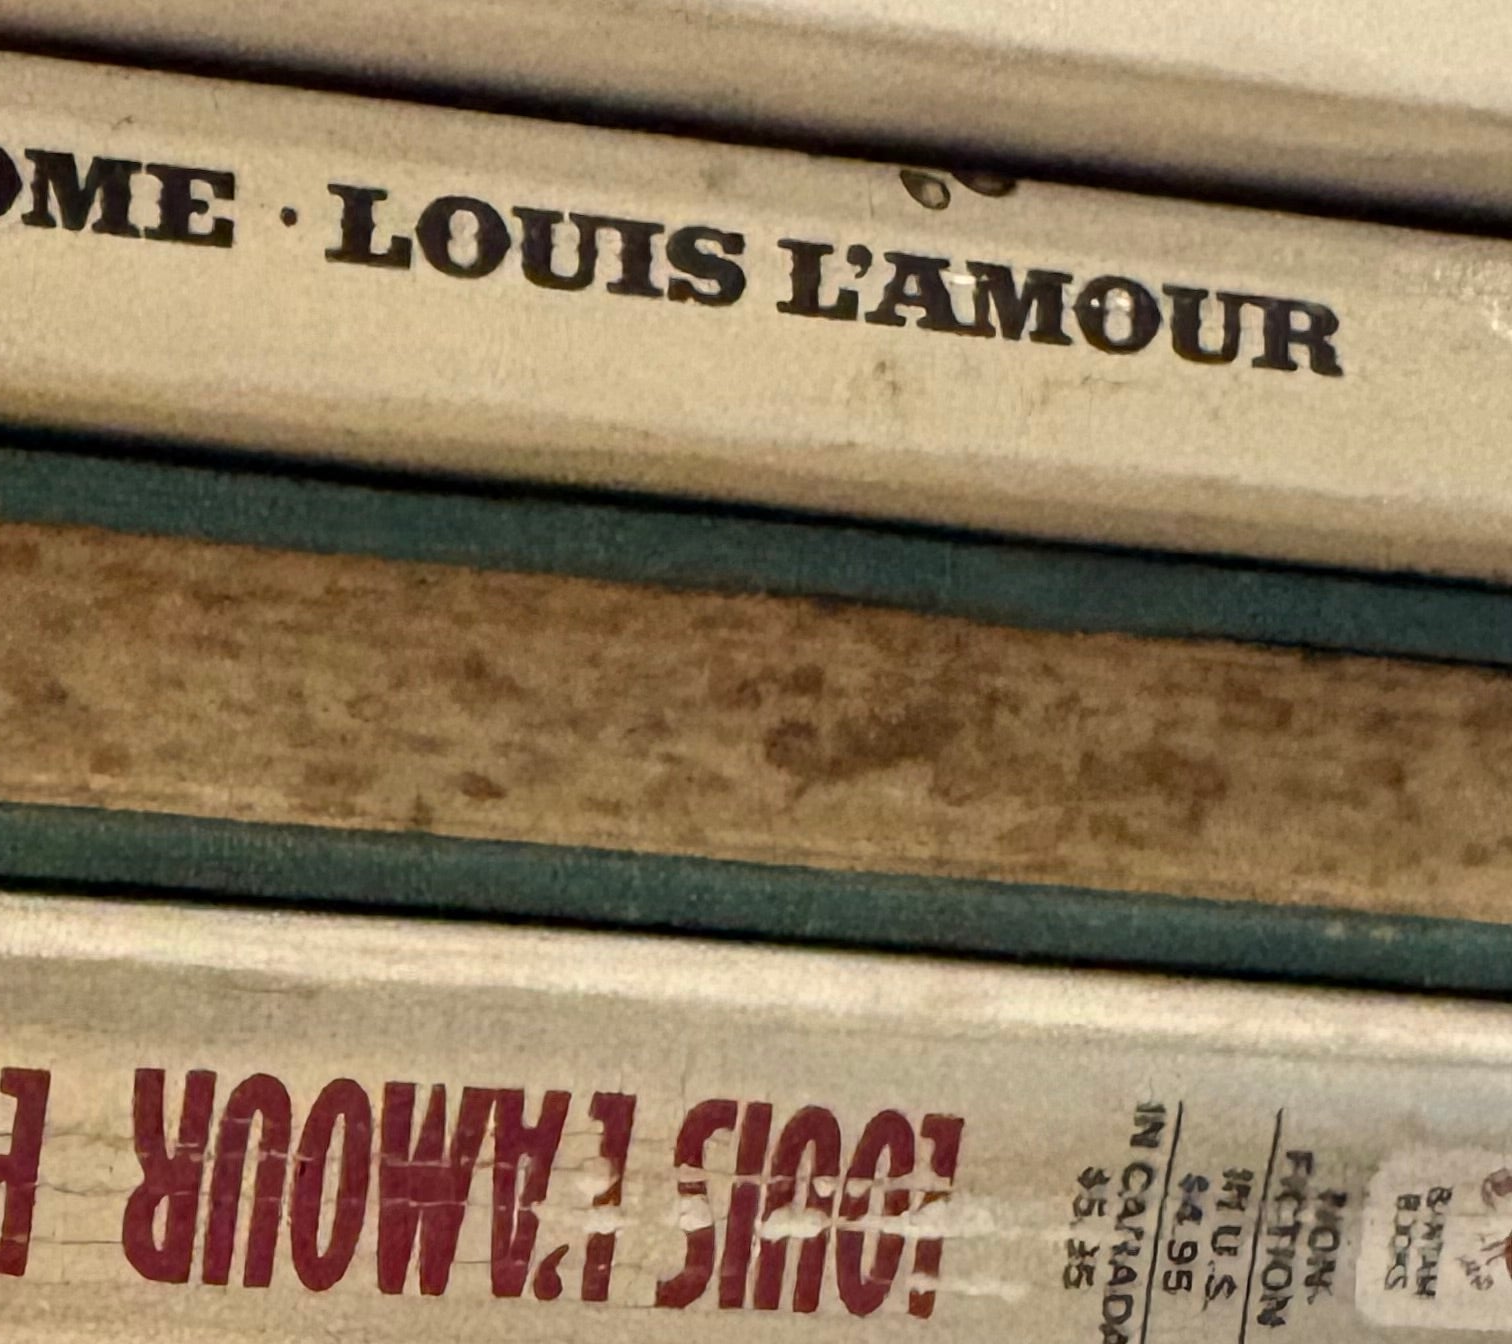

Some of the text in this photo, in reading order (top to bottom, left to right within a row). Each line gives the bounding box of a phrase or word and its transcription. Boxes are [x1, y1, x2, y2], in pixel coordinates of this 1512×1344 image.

[324, 183, 747, 307] LOUIS
[776, 239, 1343, 377] L'AMOUR
[124, 1070, 636, 1302] L'AMOUR
[1130, 1101, 1168, 1150] IN
[1255, 1150, 1315, 1329] FICTION
